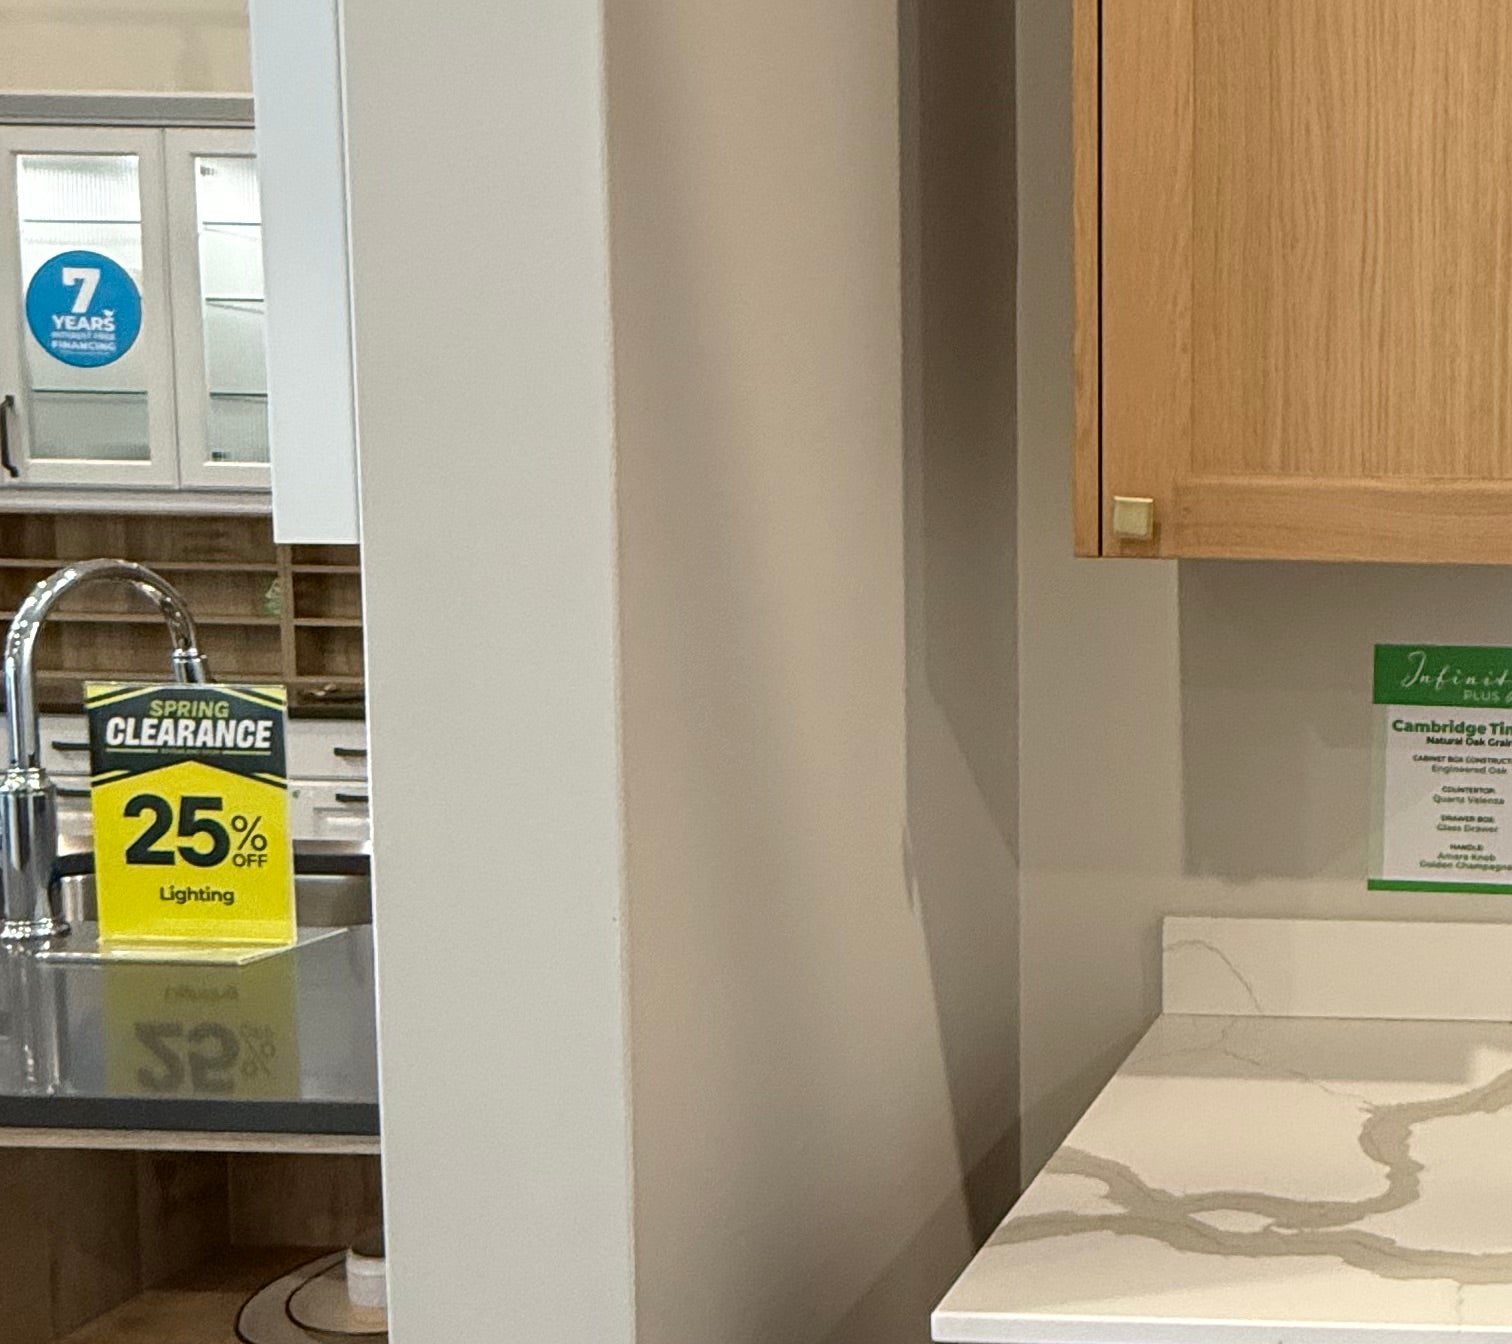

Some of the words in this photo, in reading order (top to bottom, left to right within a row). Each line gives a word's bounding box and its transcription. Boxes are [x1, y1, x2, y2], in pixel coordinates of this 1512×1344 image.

[62, 268, 101, 313] 7
[52, 315, 115, 331] YEARS
[51, 340, 117, 351] FINANCING
[1463, 690, 1500, 701] PLUS
[150, 700, 230, 718] SPRING
[105, 717, 273, 749] CLEARANCE
[1392, 720, 1486, 736] Cambridge
[1426, 736, 1462, 745] Natural
[1466, 737, 1485, 745] Oak
[1432, 764, 1486, 774] Engineered
[232, 854, 268, 868] OFF
[160, 885, 235, 905] Lighting
